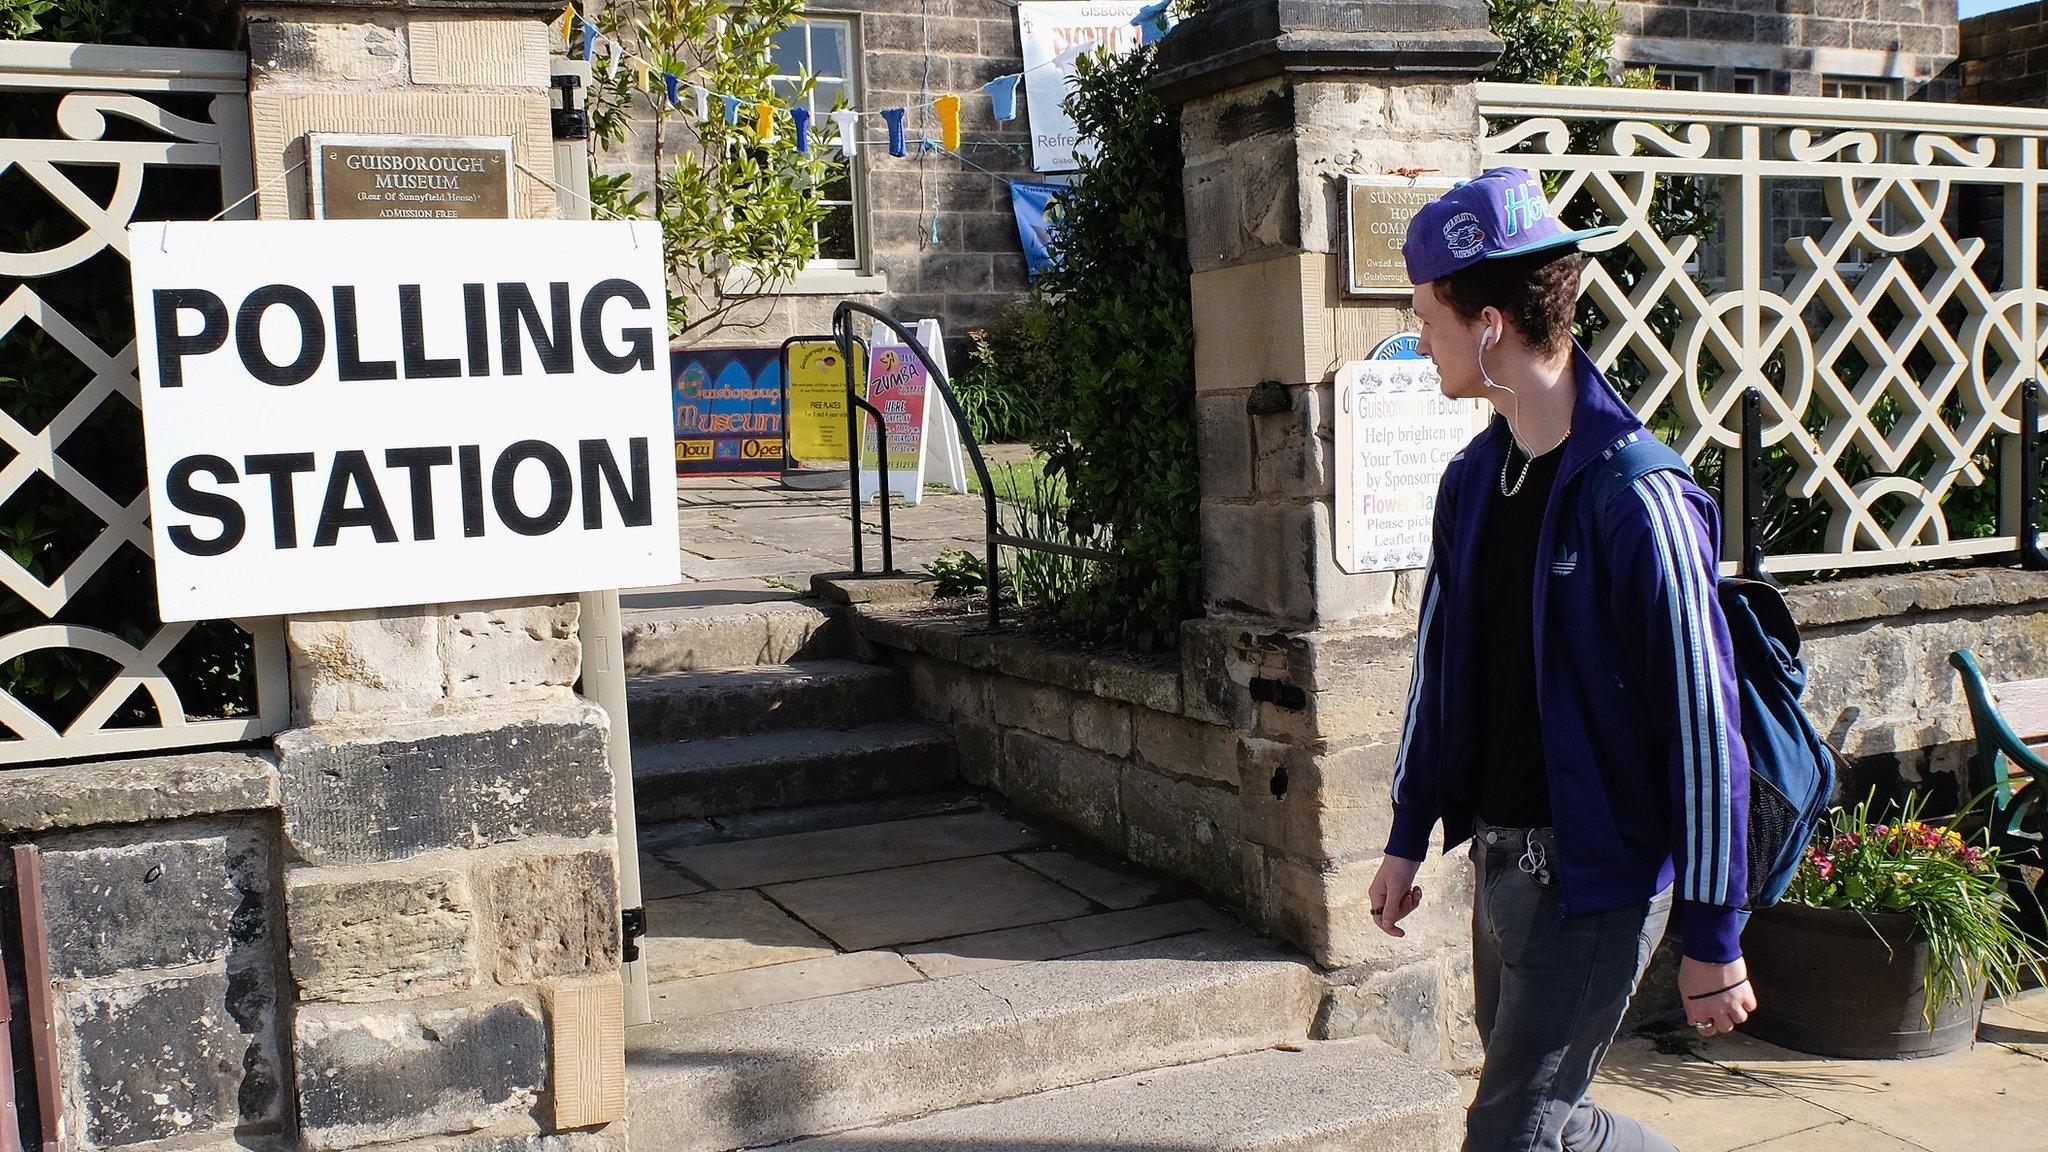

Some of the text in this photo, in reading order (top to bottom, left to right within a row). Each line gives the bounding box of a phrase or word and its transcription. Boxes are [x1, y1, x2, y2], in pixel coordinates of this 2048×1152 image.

[346, 154, 485, 172] GUISBOROUGH
[374, 173, 459, 190] MUSEUM
[357, 192, 477, 203] (Rear Of Sunnyfield House)
[379, 208, 459, 218] ADMISSION FREE
[1443, 212, 1480, 236] CHARLOTTE
[1452, 241, 1484, 259] HORNETS
[1366, 259, 1392, 268] Owned
[153, 278, 655, 388] POLLING
[871, 364, 920, 396] ZUMBA
[810, 401, 841, 409] FREE PLACES
[885, 400, 906, 413] HERE
[1426, 393, 1436, 416] in
[1365, 424, 1464, 445] Help brighten up
[1361, 451, 1391, 467] Your
[1394, 449, 1427, 466] Town
[1366, 472, 1381, 491] by
[166, 437, 653, 558] STATION
[1367, 517, 1404, 531] Please
[1375, 533, 1415, 547] Leaflet
